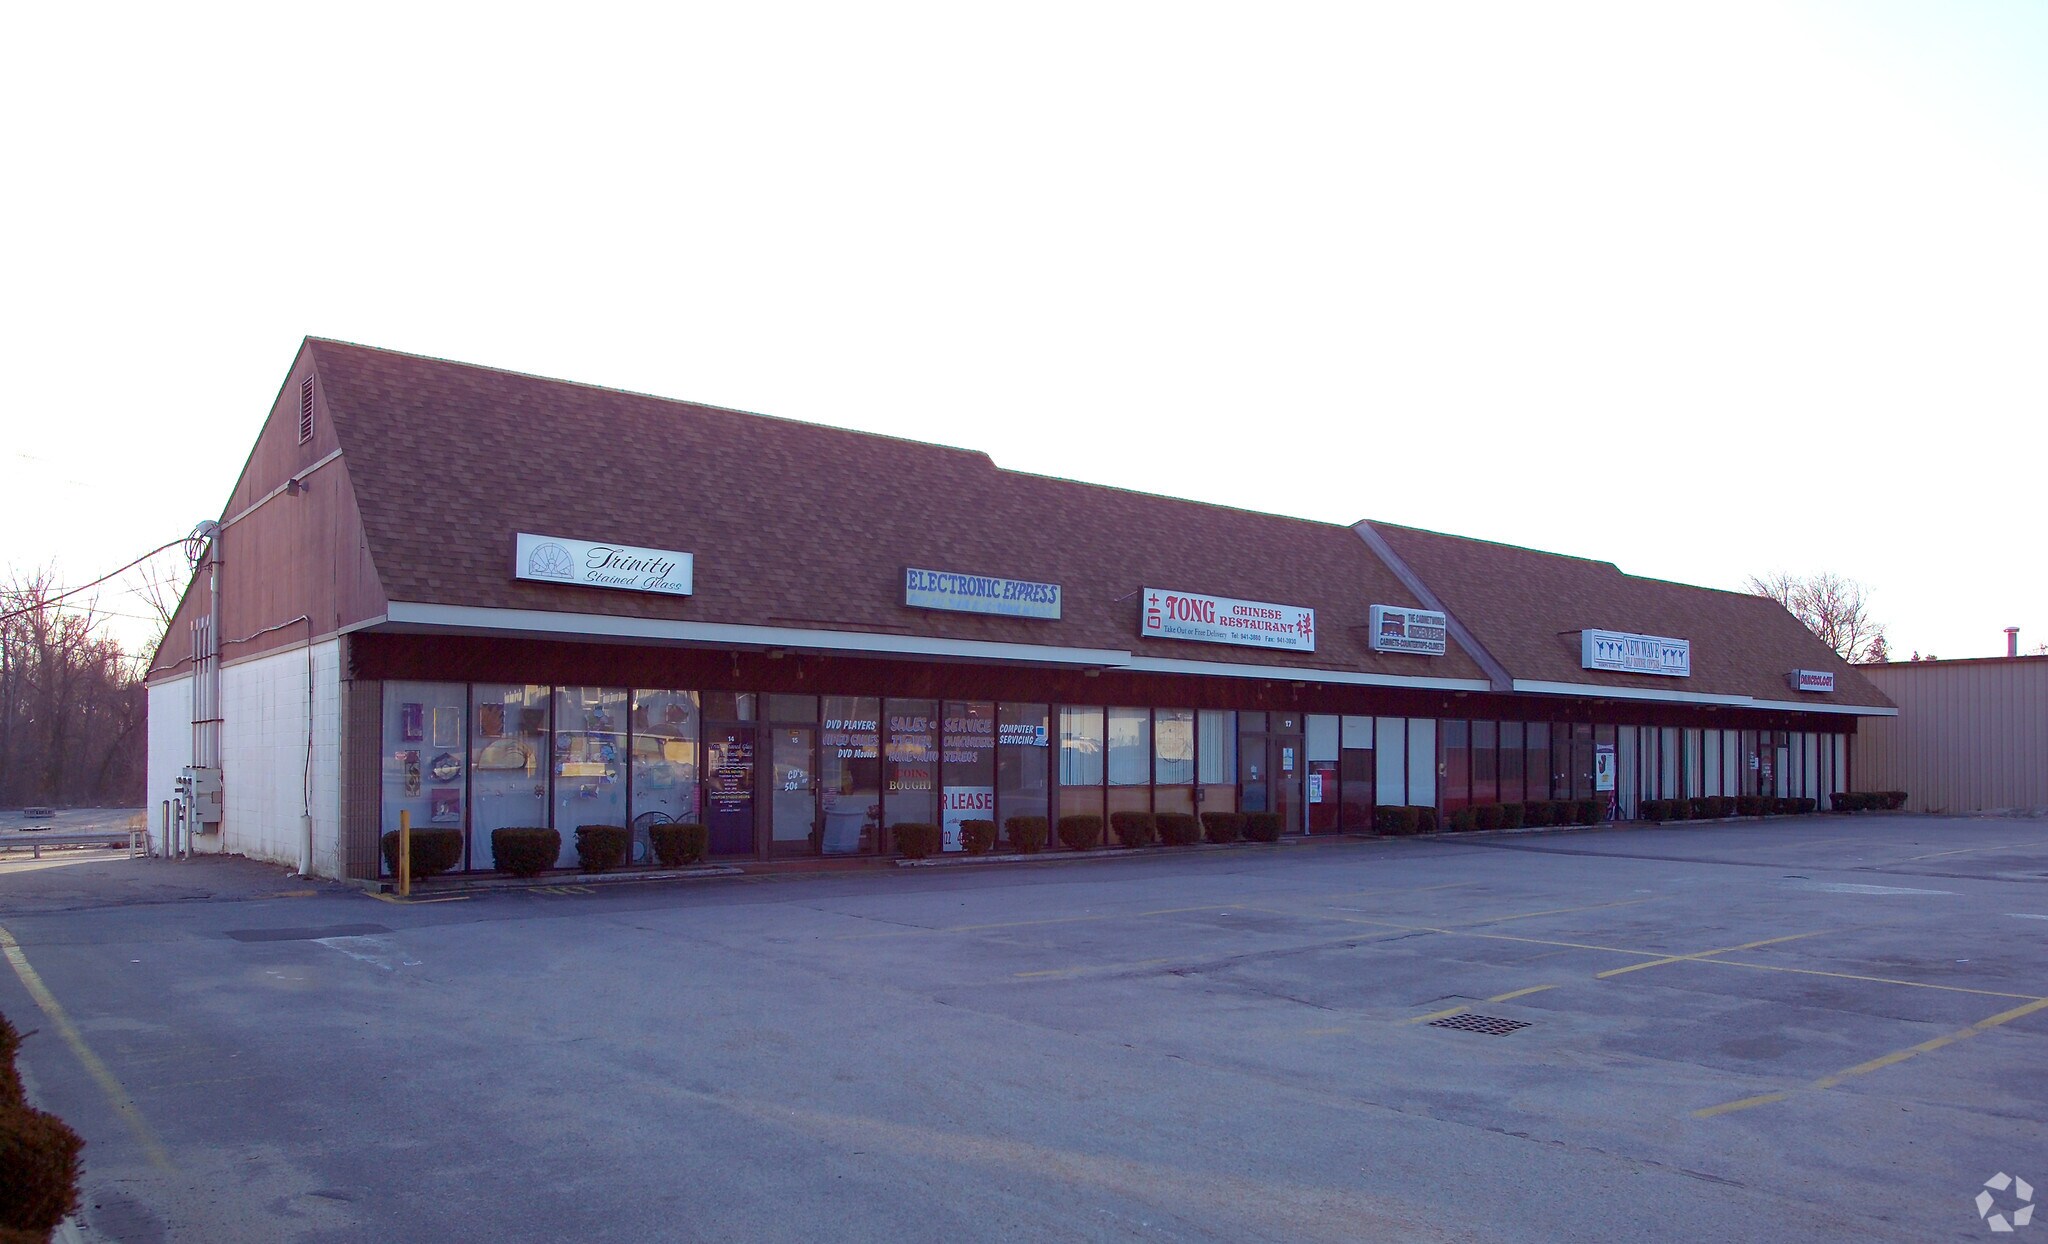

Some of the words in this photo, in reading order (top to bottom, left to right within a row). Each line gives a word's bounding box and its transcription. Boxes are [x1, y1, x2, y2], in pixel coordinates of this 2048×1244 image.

[586, 547, 676, 580] Trinity
[583, 570, 638, 586] Stained
[641, 576, 682, 591] Glass
[908, 570, 1000, 598] ELECTRONIC
[1003, 581, 1057, 604] EXPRESS
[1166, 595, 1215, 624] TONG
[1164, 625, 1176, 634] Take
[1177, 626, 1187, 635] Out
[1194, 628, 1206, 636] Free
[1206, 629, 1227, 640] Delivery
[1220, 616, 1294, 634] RESTAURANT
[1625, 640, 1640, 656] NEW
[1641, 642, 1660, 658] WAVE
[826, 719, 841, 729] DVD
[843, 720, 876, 730] PLAYERS
[890, 716, 927, 732] SALES
[944, 718, 992, 733] SERVICE
[1000, 724, 1034, 733] COMPUTER
[850, 734, 879, 746] GAMES
[999, 735, 1034, 745] SERVICING
[838, 749, 852, 758] DVD
[854, 749, 877, 758] Movies
[787, 768, 803, 780] CD's
[951, 793, 992, 809] LEASE
